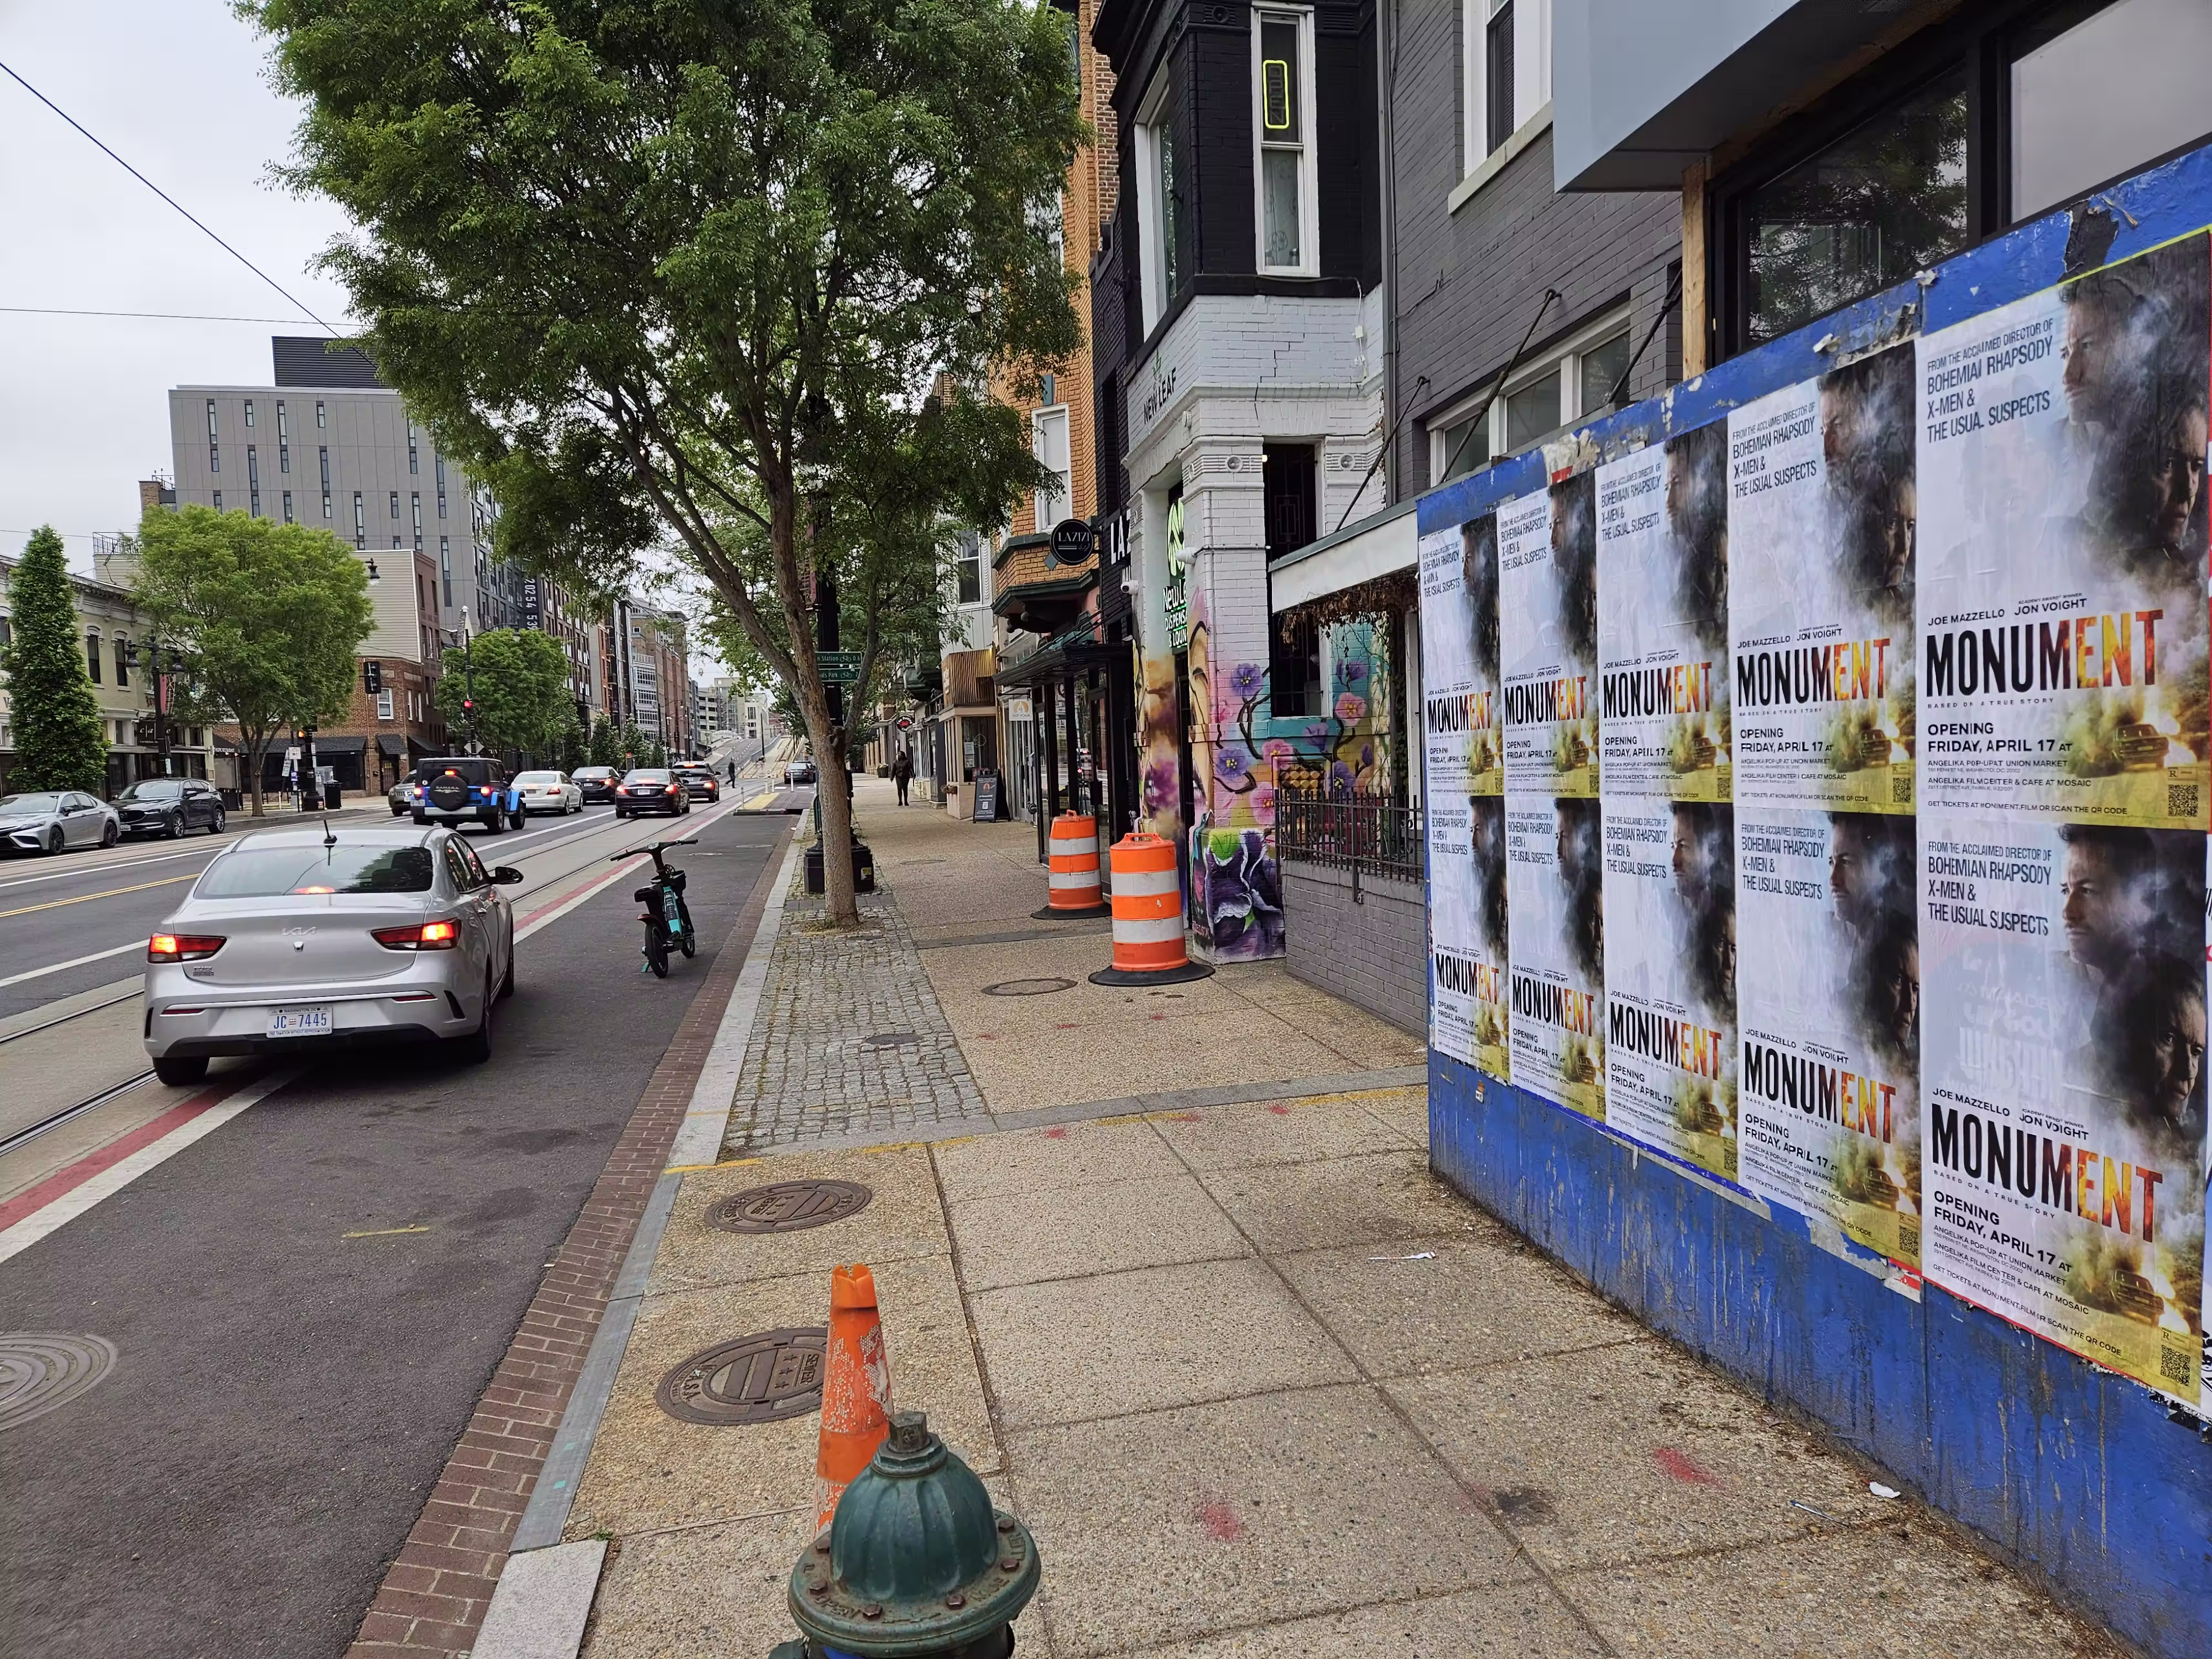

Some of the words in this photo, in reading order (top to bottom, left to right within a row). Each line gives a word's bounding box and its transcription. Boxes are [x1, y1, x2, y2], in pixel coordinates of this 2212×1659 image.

[1928, 358, 1947, 373] FROM
[1948, 351, 1961, 364] THE
[2004, 322, 2041, 346] DIRECTOR
[2043, 318, 2053, 332] OF
[1987, 335, 2053, 375] RHAPSODY
[1144, 389, 1157, 425] NEW
[1158, 366, 1176, 408] LEAF
[1927, 391, 1964, 420] X-MEN
[1967, 388, 1975, 408] &
[1927, 421, 1948, 444] THE
[1989, 390, 2051, 426] SUSPECTS
[1733, 432, 1771, 459] BOHEMIAN
[1773, 416, 1815, 446] RHAPSODY
[1734, 457, 1759, 479] X-MEN
[1760, 456, 1765, 471] &
[1734, 481, 1748, 498] THE
[1750, 473, 1772, 494] USUAL
[1774, 460, 1817, 487] SUSPECTS
[1058, 532, 1089, 542] LAZIZI
[1928, 615, 1948, 626] JOE
[1950, 608, 2005, 624] MAZZELLO
[2015, 604, 2039, 617] JON
[2042, 598, 2088, 612] VOIGHT
[1168, 633, 1172, 648] &
[1927, 609, 2164, 697] MONUMENT
[1737, 638, 1890, 707] MONUMENT
[1504, 676, 1587, 726] MONUMENT
[1603, 662, 1712, 718] MONUMENT
[1428, 690, 1491, 734] MONUMENT
[1507, 740, 1531, 749] OPENING
[1605, 736, 1637, 745] OPENING
[1740, 728, 1783, 739] OPENING
[1928, 722, 1994, 735] OPENING
[1605, 748, 1631, 758] FRIDAY,
[1656, 748, 1665, 757] 17
[1741, 742, 1776, 754] FRIDAY,
[1777, 742, 1808, 753] APRIL
[1812, 742, 1823, 752] 17
[1928, 740, 1982, 753] FRIDAY,
[1986, 739, 2032, 752] APRIL
[2038, 739, 2056, 752] 17
[2058, 743, 2073, 752] AT
[1928, 841, 1948, 853] FROM
[1949, 843, 1959, 854] THE
[1962, 844, 2004, 857] ACCLAIMED
[2043, 850, 2052, 862] OF
[1928, 857, 1986, 878] BOHEMIAN
[1990, 861, 2052, 885] RHAPSODY
[1928, 879, 1964, 900] X-MEN
[1968, 884, 1976, 901] &
[1928, 902, 1949, 921] THE
[1951, 906, 1987, 927] USUAL
[1990, 910, 2049, 936] SUSPECTS
[1436, 953, 1499, 1005] MONUMENT
[298, 1013, 326, 1027] 7445
[1438, 1000, 1458, 1013] OPENING
[1512, 974, 1594, 1037] MONUMENT
[1513, 1029, 1538, 1043] OPENING
[1610, 1001, 1722, 1081] MONUMENT
[1611, 1063, 1645, 1082] OPENING
[1611, 1074, 1639, 1093] FRIDAY,
[1640, 1086, 1662, 1102] APRIL
[1663, 1095, 1672, 1105] 17
[1745, 1041, 1896, 1144] MONUMENT
[1933, 1088, 1953, 1100] JOE
[1955, 1094, 2010, 1117] MAZZELLO
[1745, 1114, 1789, 1139] OPENING
[2019, 1113, 2043, 1126] JON
[2046, 1119, 2089, 1140] VOIGHT
[1745, 1126, 1781, 1150] FRIDAY,
[1783, 1142, 1814, 1163] APRIL
[1817, 1155, 1828, 1168] 17
[1830, 1164, 1838, 1173] AT
[1932, 1103, 2163, 1243] MONUMENT
[1934, 1170, 1962, 1183] BASED
[1968, 1182, 1979, 1191] ON
[1994, 1192, 2019, 1206] TRUE
[1934, 1191, 2000, 1225] OPENING
[1934, 1206, 1986, 1238] FRIDAY,
[1990, 1230, 2034, 1258] APRIL
[2037, 1250, 2056, 1265] 17
[2058, 1262, 2072, 1272] AT
[1934, 1225, 1969, 1244] ANGELIKA
[1970, 1240, 1997, 1255] POP-UP
[2009, 1256, 2032, 1272] UNION
[1934, 1241, 1969, 1261] ANGELIKA
[1970, 1257, 1985, 1269] FILM
[2023, 1281, 2041, 1295] CAFE
[2043, 1291, 2053, 1299] AT
[2056, 1295, 2089, 1315] MOSAIC
[1933, 1264, 1945, 1273] GET
[1947, 1270, 1971, 1287] TICKETS
[2047, 1318, 2069, 1332] SCAN
[2070, 1327, 2084, 1340] THE
[2086, 1335, 2098, 1345] QR
[2099, 1341, 2122, 1357] CODE
[2163, 1331, 2169, 1340] R
